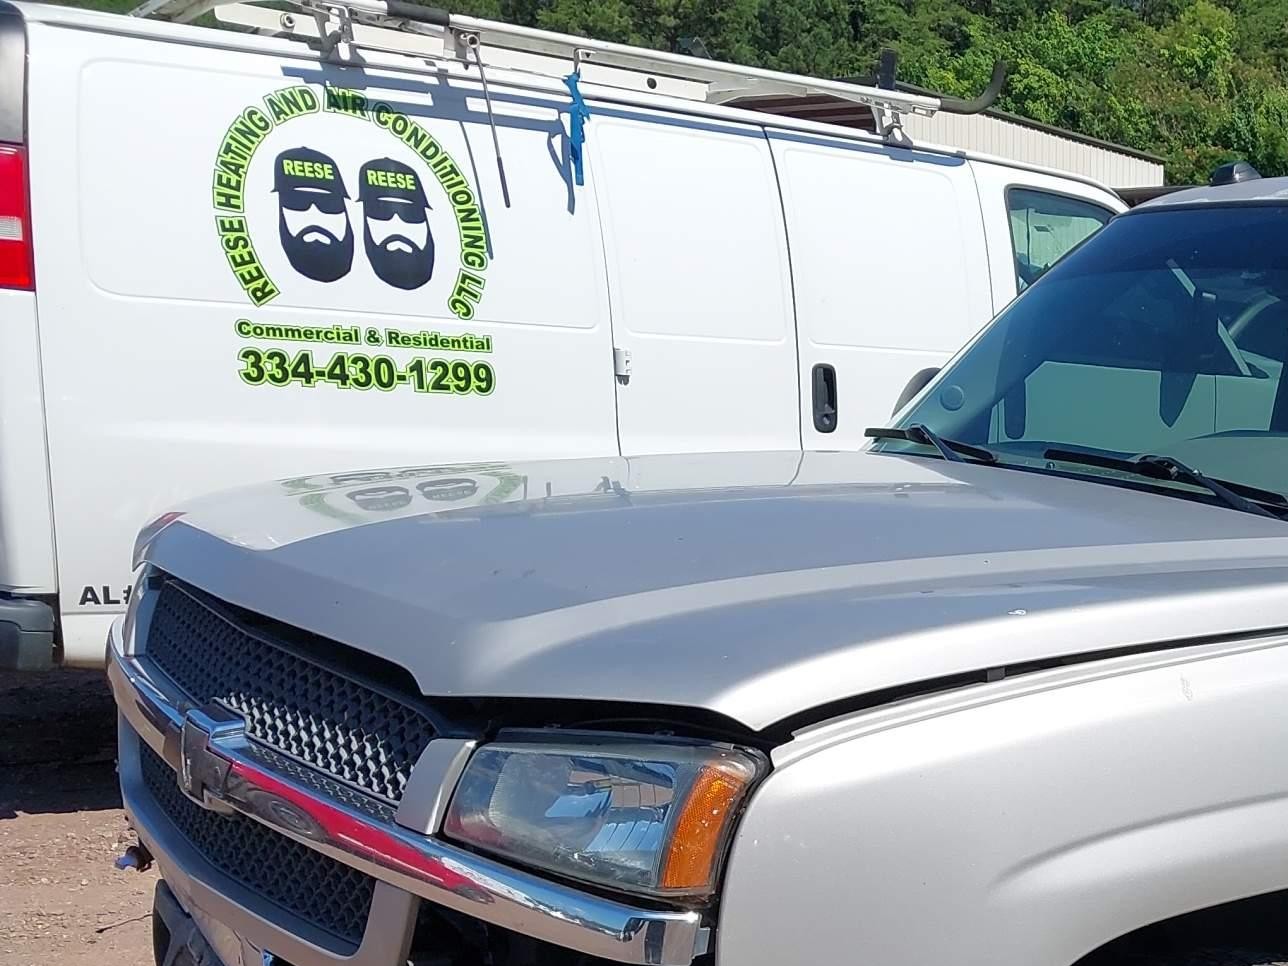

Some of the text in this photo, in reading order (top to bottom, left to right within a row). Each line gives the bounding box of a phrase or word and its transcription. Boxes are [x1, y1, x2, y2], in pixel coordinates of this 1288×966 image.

[283, 159, 335, 181] REESE
[366, 169, 417, 190] REESE
[215, 87, 488, 318] REESE HEATING AND AIR CONDITIONING LLC
[236, 321, 492, 351] Commercial & Residential
[239, 349, 495, 394] 334-430-1299
